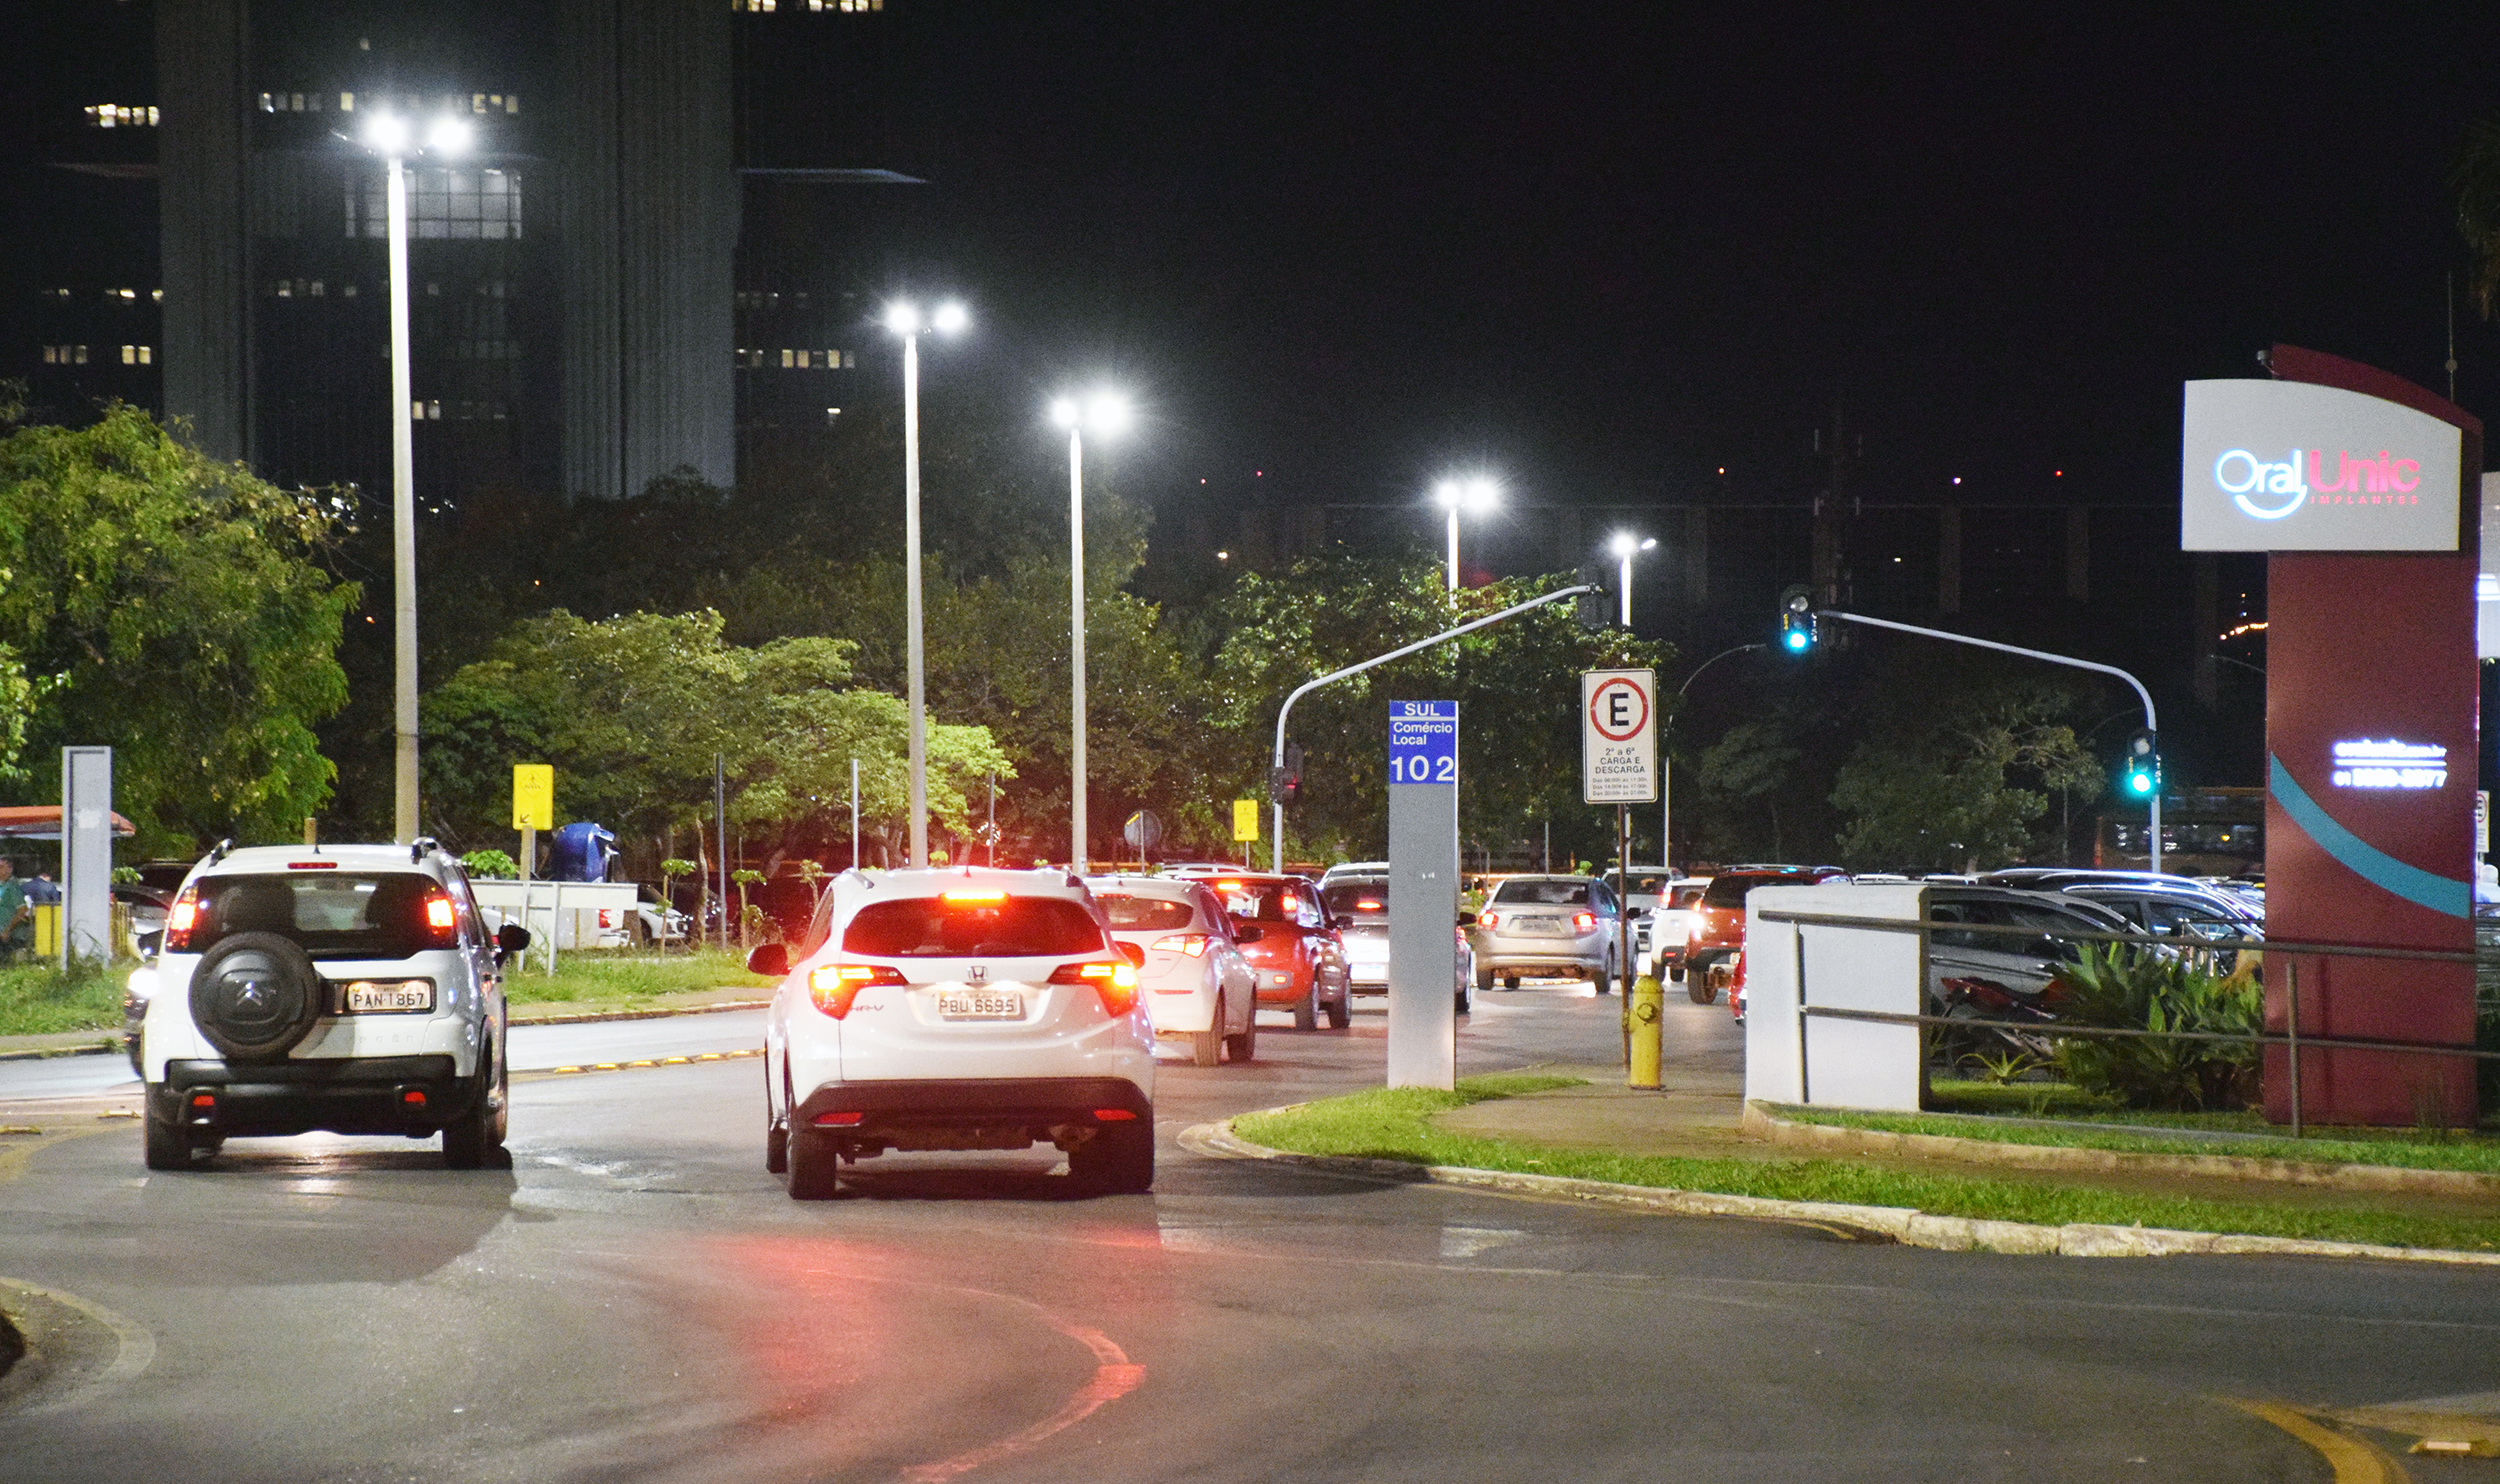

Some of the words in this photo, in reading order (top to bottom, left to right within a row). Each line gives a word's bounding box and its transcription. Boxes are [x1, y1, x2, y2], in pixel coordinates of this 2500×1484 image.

[2216, 449, 2302, 493] Oral
[2308, 449, 2421, 493] Unic
[2310, 495, 2418, 505] IMPLANTES
[1404, 702, 1440, 716] SUL
[1609, 692, 1629, 726] E
[1393, 721, 1453, 733] Comércio
[1393, 734, 1427, 745] Local
[1600, 757, 1632, 765] CARGA
[1635, 756, 1640, 764] E
[1391, 755, 1454, 781] 102
[1595, 765, 1646, 774] DESCARGA
